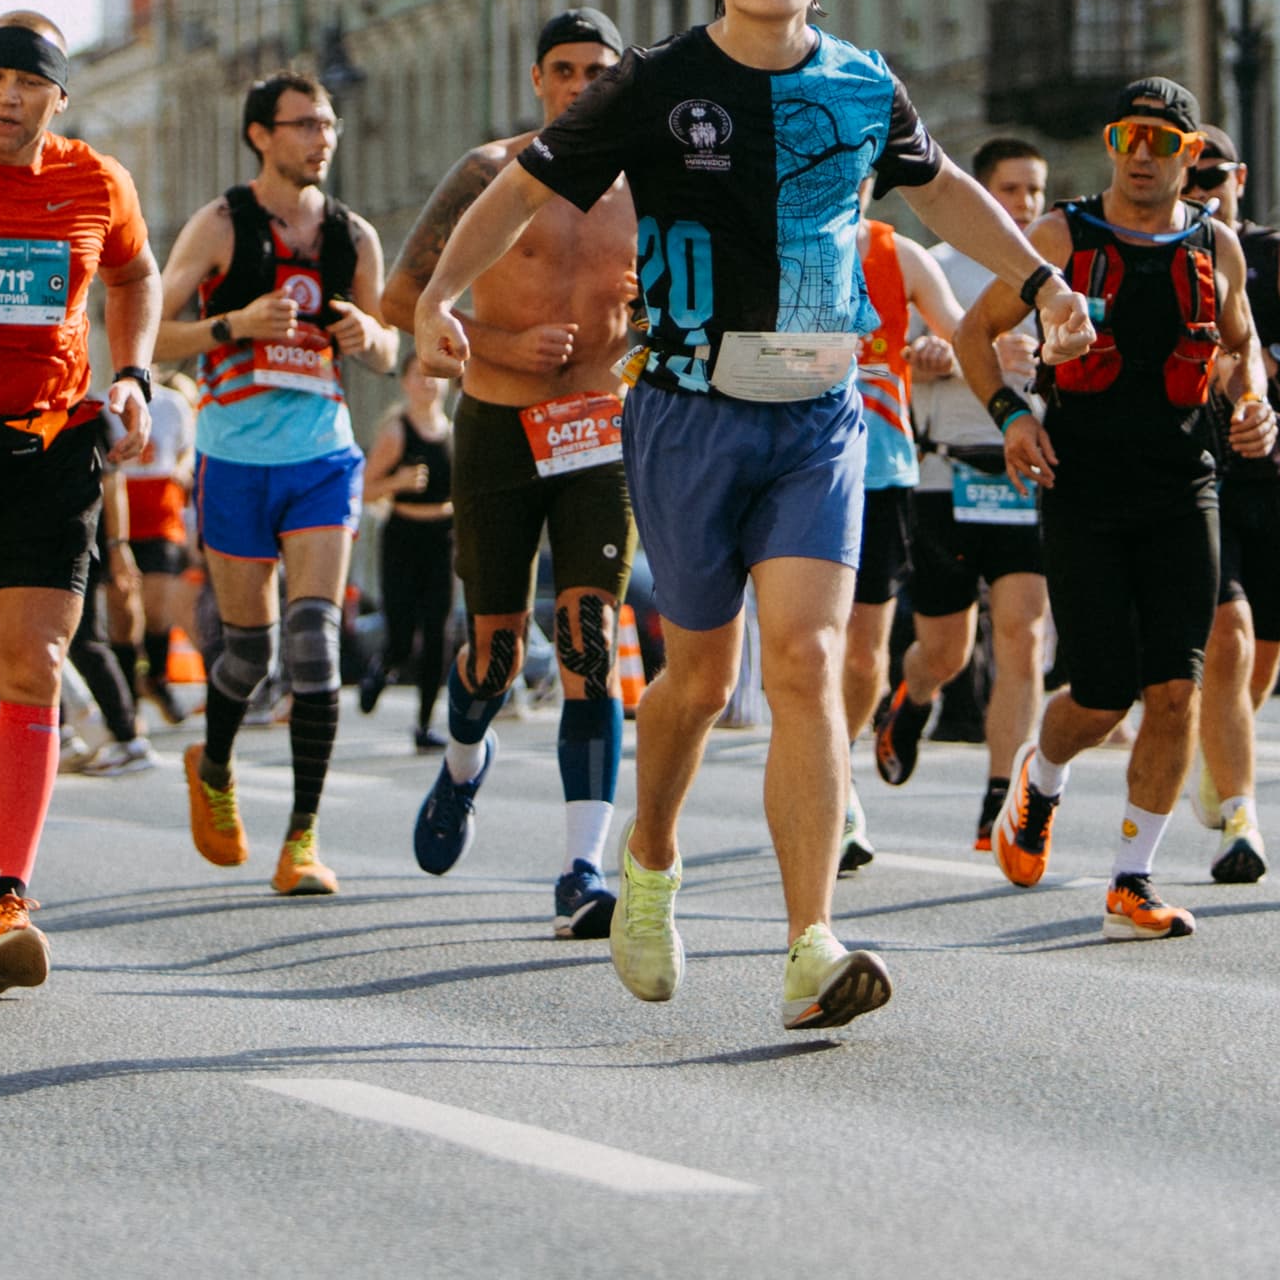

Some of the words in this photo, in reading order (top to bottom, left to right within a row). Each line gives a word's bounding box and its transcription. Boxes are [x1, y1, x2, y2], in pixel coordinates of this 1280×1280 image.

[50, 275, 64, 291] C
[637, 215, 714, 329] 20
[264, 344, 317, 368] 10130
[547, 417, 599, 447] 6472
